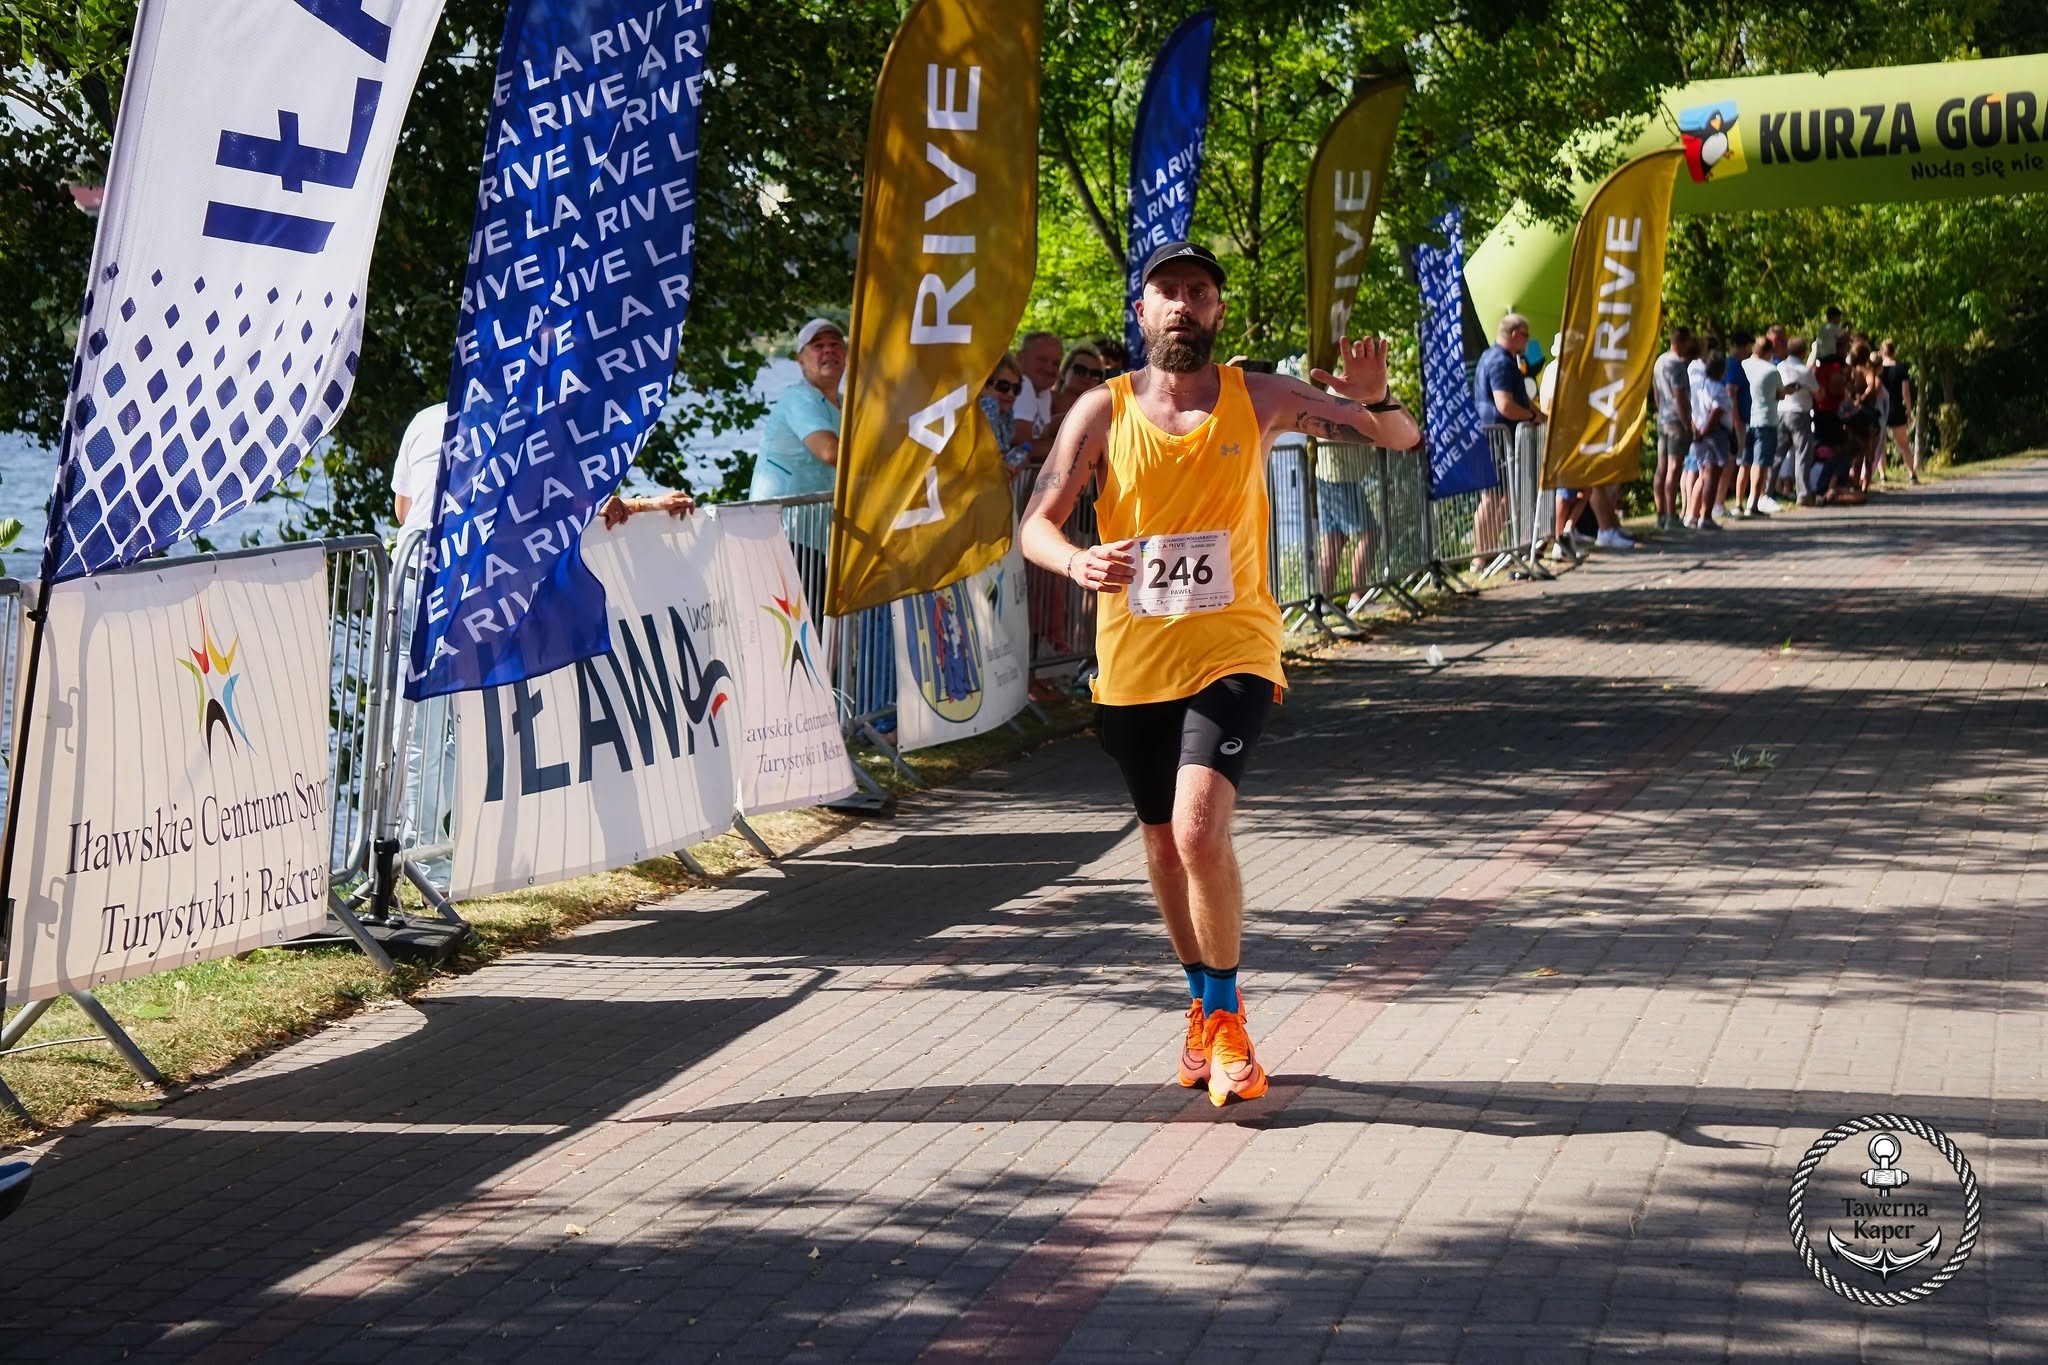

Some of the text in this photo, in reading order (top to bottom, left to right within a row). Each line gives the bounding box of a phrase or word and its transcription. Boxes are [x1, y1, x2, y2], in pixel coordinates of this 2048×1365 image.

[523, 46, 583, 90] LA
[590, 2, 667, 65] RIV
[528, 72, 629, 137] RIVE
[1759, 90, 2048, 165] KURZA GÓR
[479, 144, 570, 211] RIVE
[622, 74, 704, 133] RIVE
[1911, 152, 2045, 180] Nuda się nie
[525, 194, 582, 240] LA
[1141, 168, 1168, 196] LA
[1147, 180, 1187, 222] RIVE
[461, 178, 696, 315] RIVE RIVE
[550, 248, 632, 307] RIVE
[643, 223, 695, 267] LA
[586, 295, 654, 340] LA
[894, 63, 982, 530] LA RIVE
[1579, 216, 1641, 455] LA RIVE
[443, 320, 686, 471] RIVE LA RIV
[1440, 412, 1469, 446] RIVE
[471, 429, 555, 503] RIVE
[566, 399, 633, 445] LA
[1434, 445, 1462, 480] RIVE
[421, 507, 498, 574] RIVE
[506, 476, 575, 525] LA
[460, 553, 519, 601] LA
[1147, 553, 1214, 589] 246
[1170, 588, 1193, 596] PAWEŁ
[406, 576, 547, 683] LA RIV
[757, 743, 816, 779] Turystyki
[64, 803, 194, 876] Iławskie
[201, 790, 296, 847] Centrum
[101, 858, 329, 958] Turystyki i Rekrea
